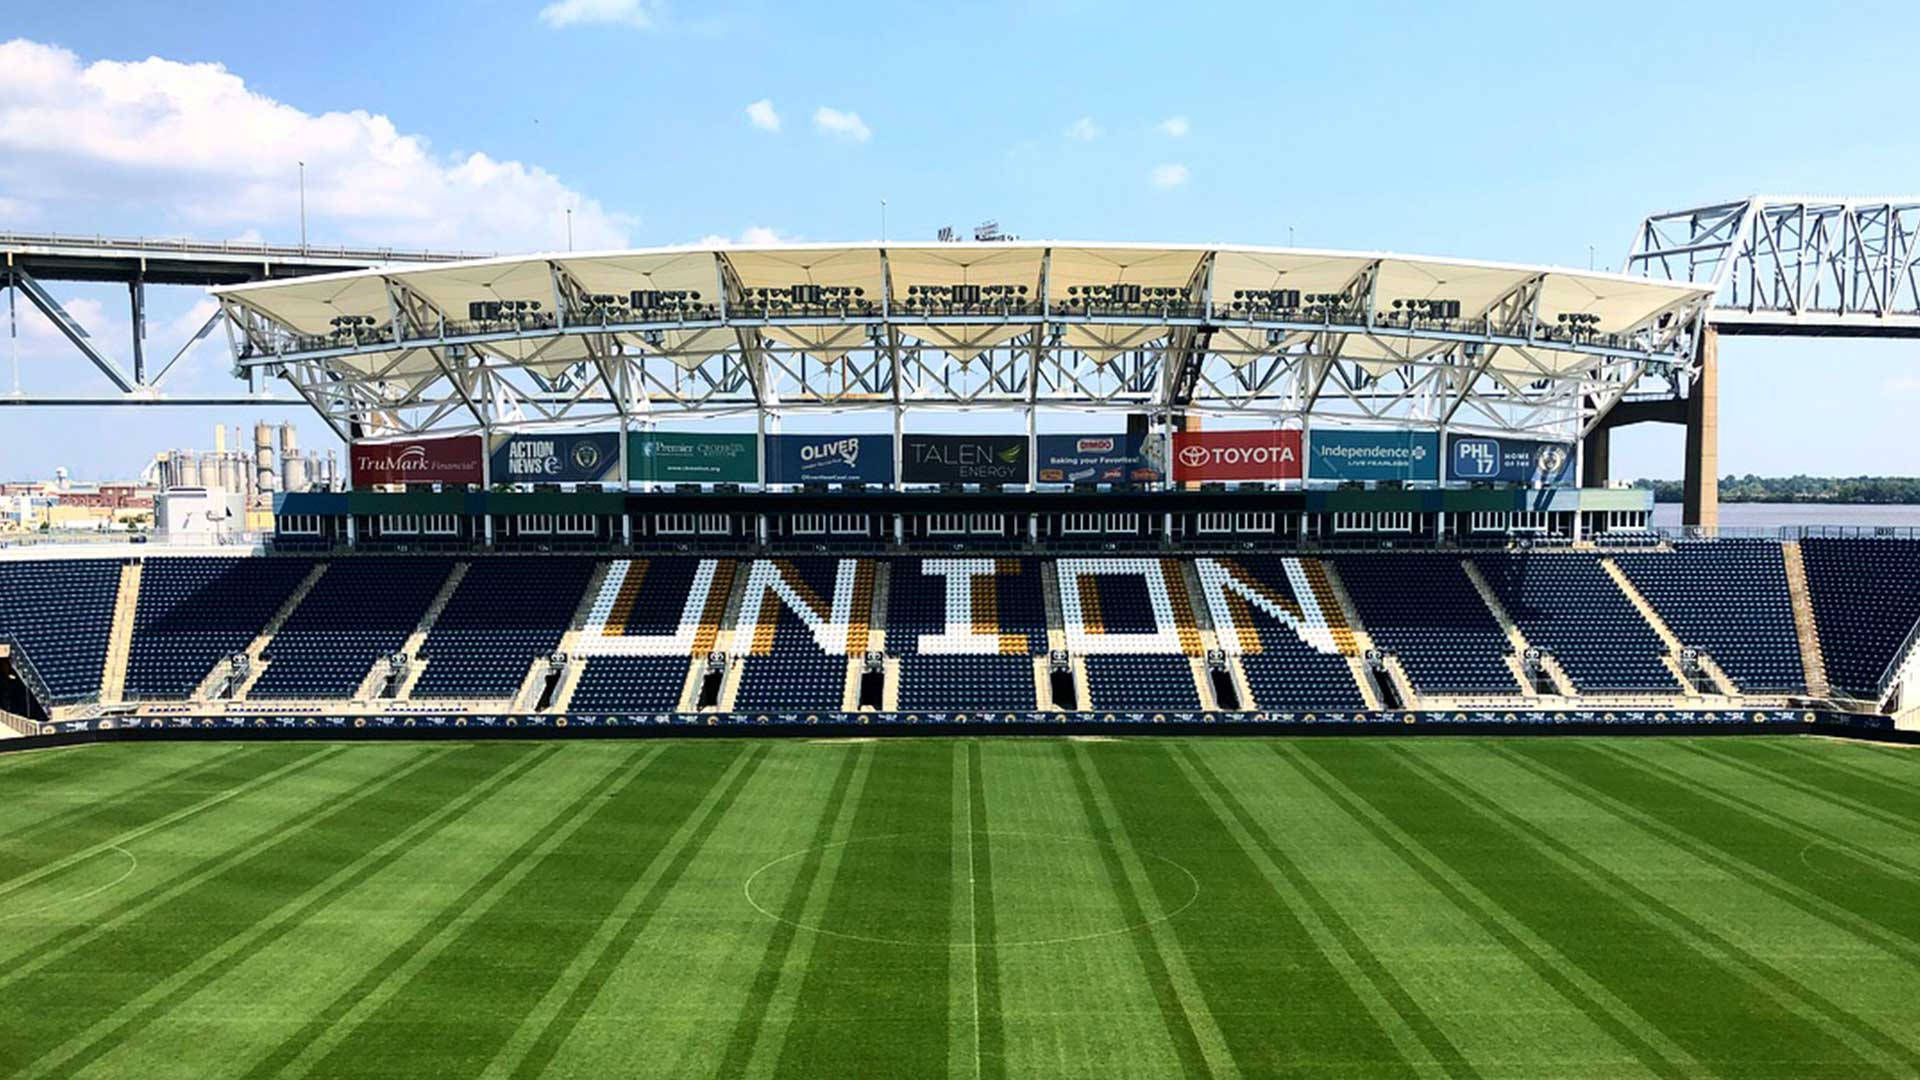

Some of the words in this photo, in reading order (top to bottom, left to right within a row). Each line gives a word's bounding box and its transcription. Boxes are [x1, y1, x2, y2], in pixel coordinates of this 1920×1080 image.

[509, 441, 554, 458] ACTION
[801, 438, 859, 461] OLIVER
[910, 443, 993, 465] TALEN
[1211, 447, 1294, 464] TOYOTA
[1321, 445, 1410, 459] Independence
[1460, 444, 1494, 458] PHL
[358, 456, 428, 471] TruMark
[508, 459, 542, 474] NEWS
[1477, 460, 1494, 473] 17
[960, 466, 1016, 477] ENERGY
[572, 558, 1352, 656] UNION
